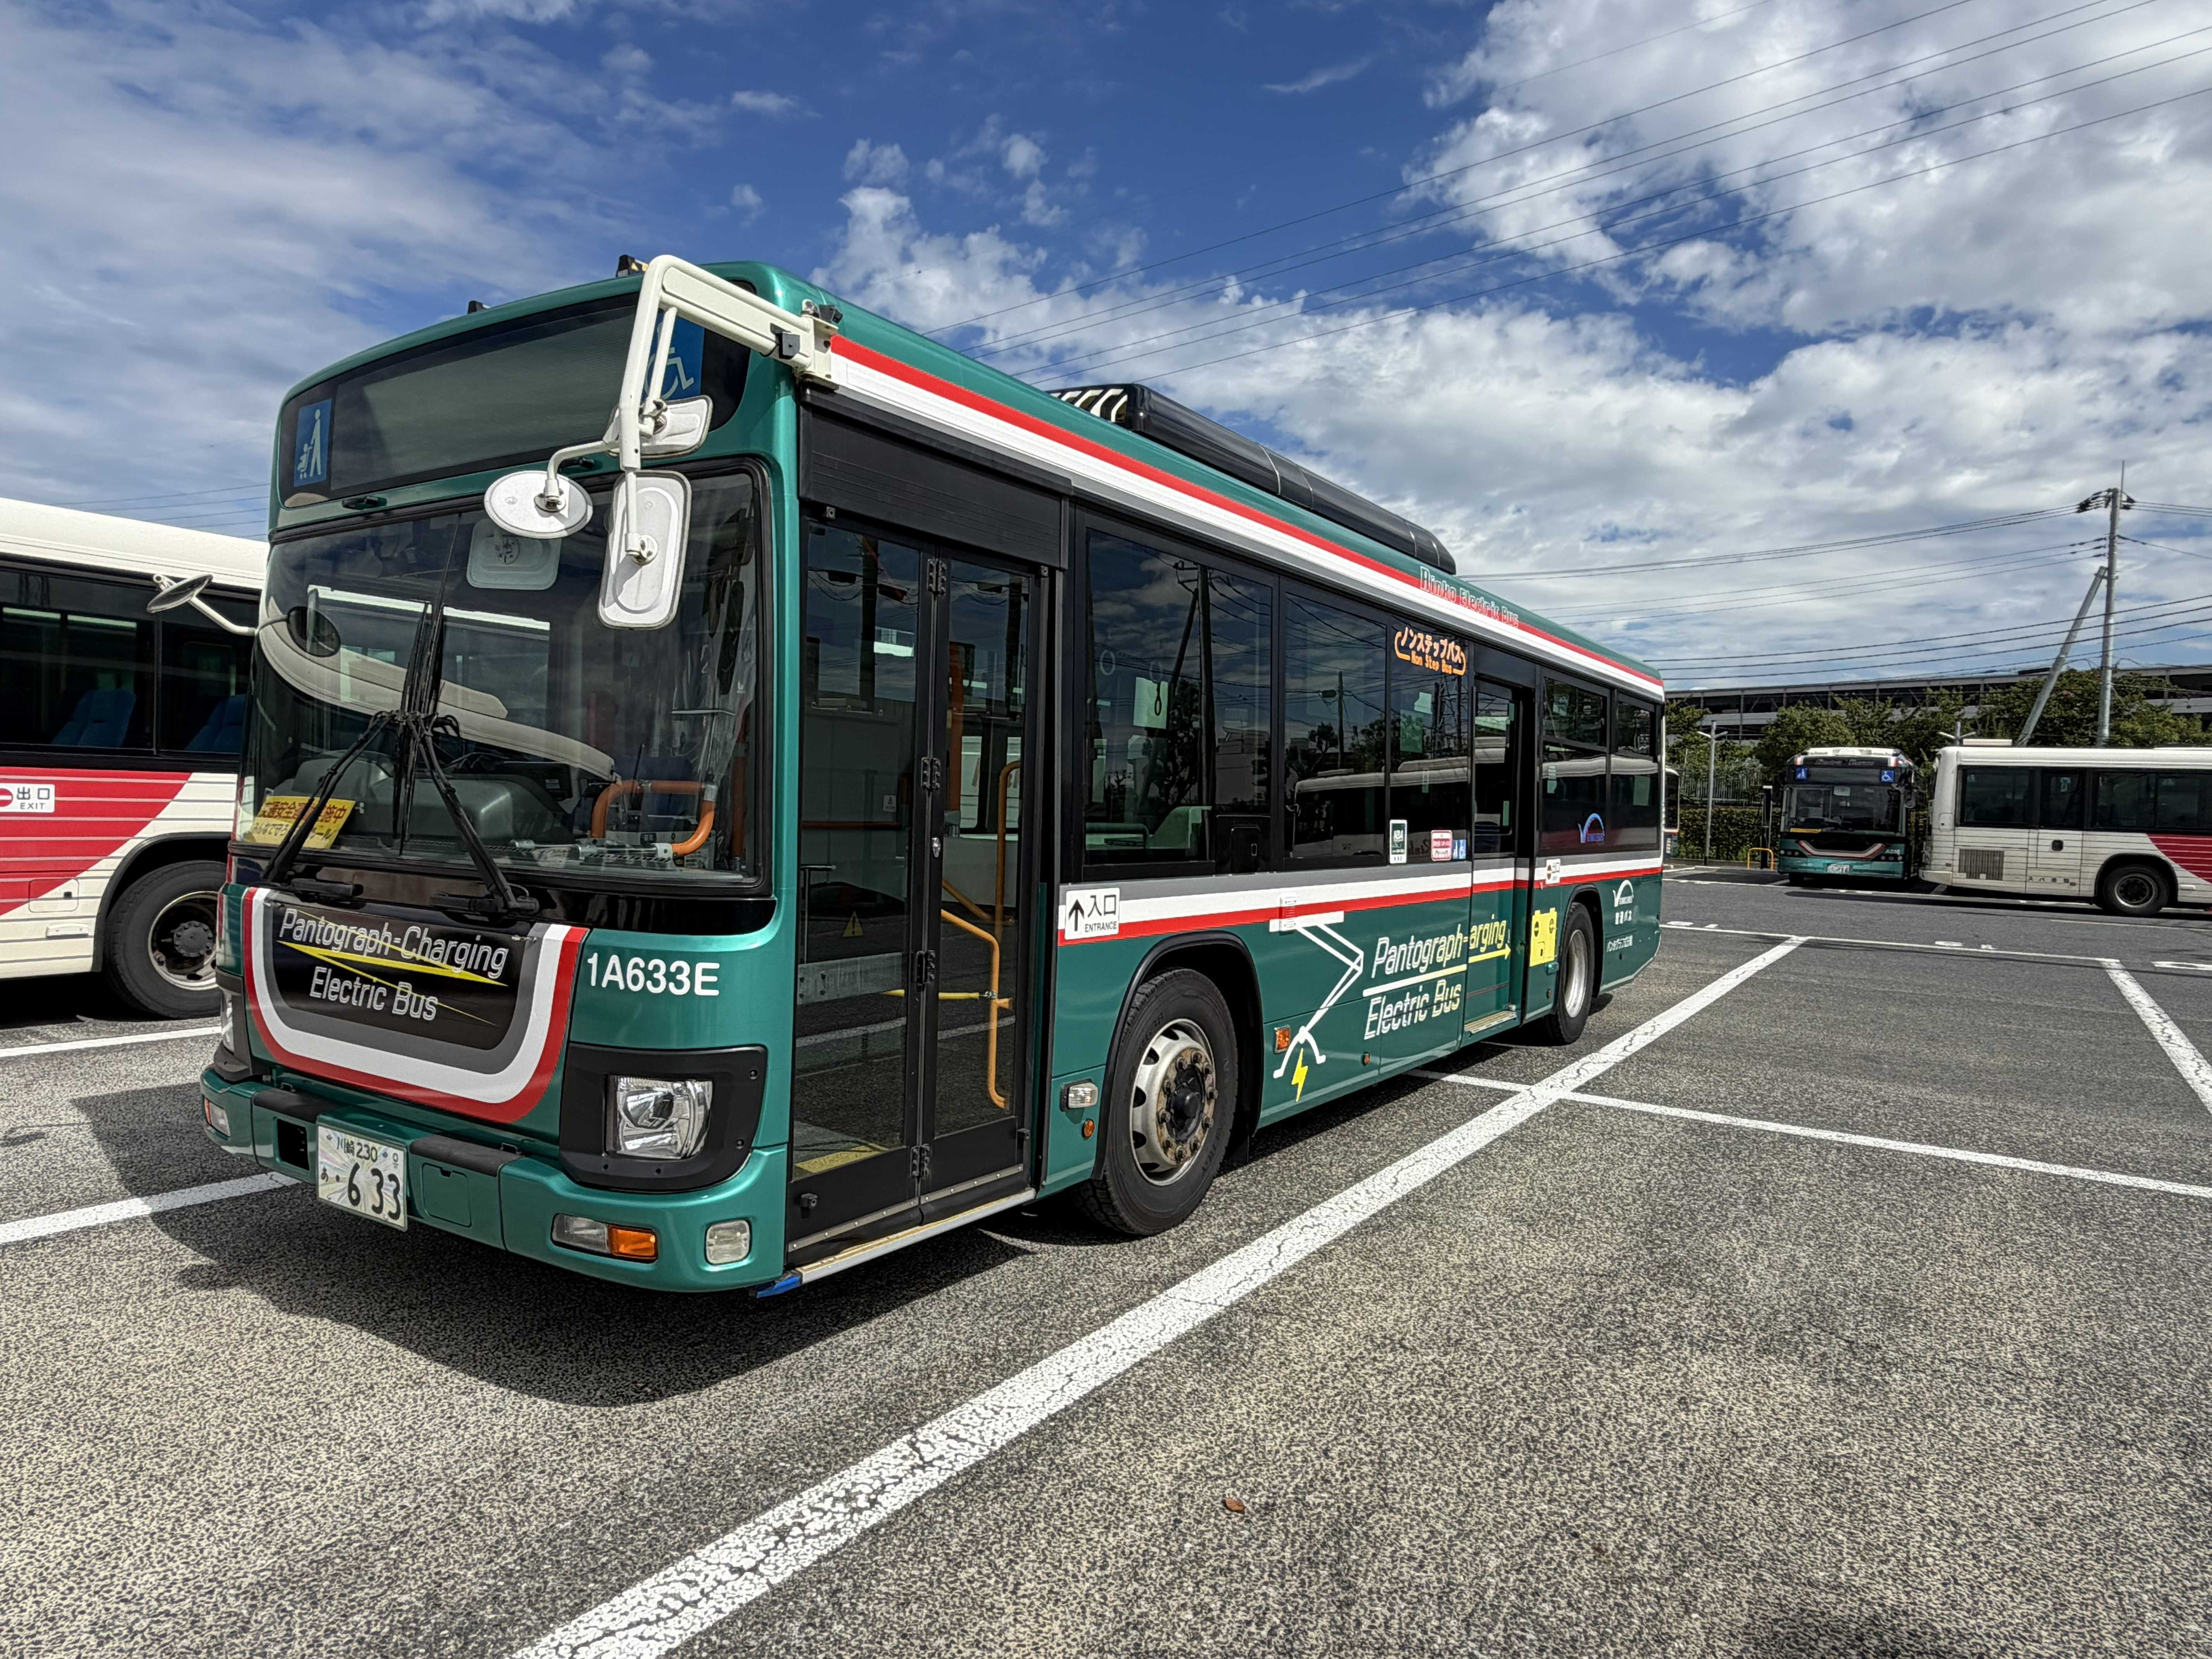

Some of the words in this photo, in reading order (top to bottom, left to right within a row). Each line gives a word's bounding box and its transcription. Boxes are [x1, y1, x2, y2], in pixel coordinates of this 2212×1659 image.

[17, 787, 50, 800] 出口
[1085, 921, 1117, 933] ENTRANCE
[1087, 894, 1116, 918] 入口
[279, 908, 509, 979] Pantograph-Charging
[1371, 914, 1507, 979] Pantograph-arging
[309, 966, 387, 1010] Electric
[392, 981, 438, 1021] Bus
[587, 953, 720, 996] 1A633E
[1364, 985, 1429, 1041] Electric
[1432, 979, 1462, 1018] Bus
